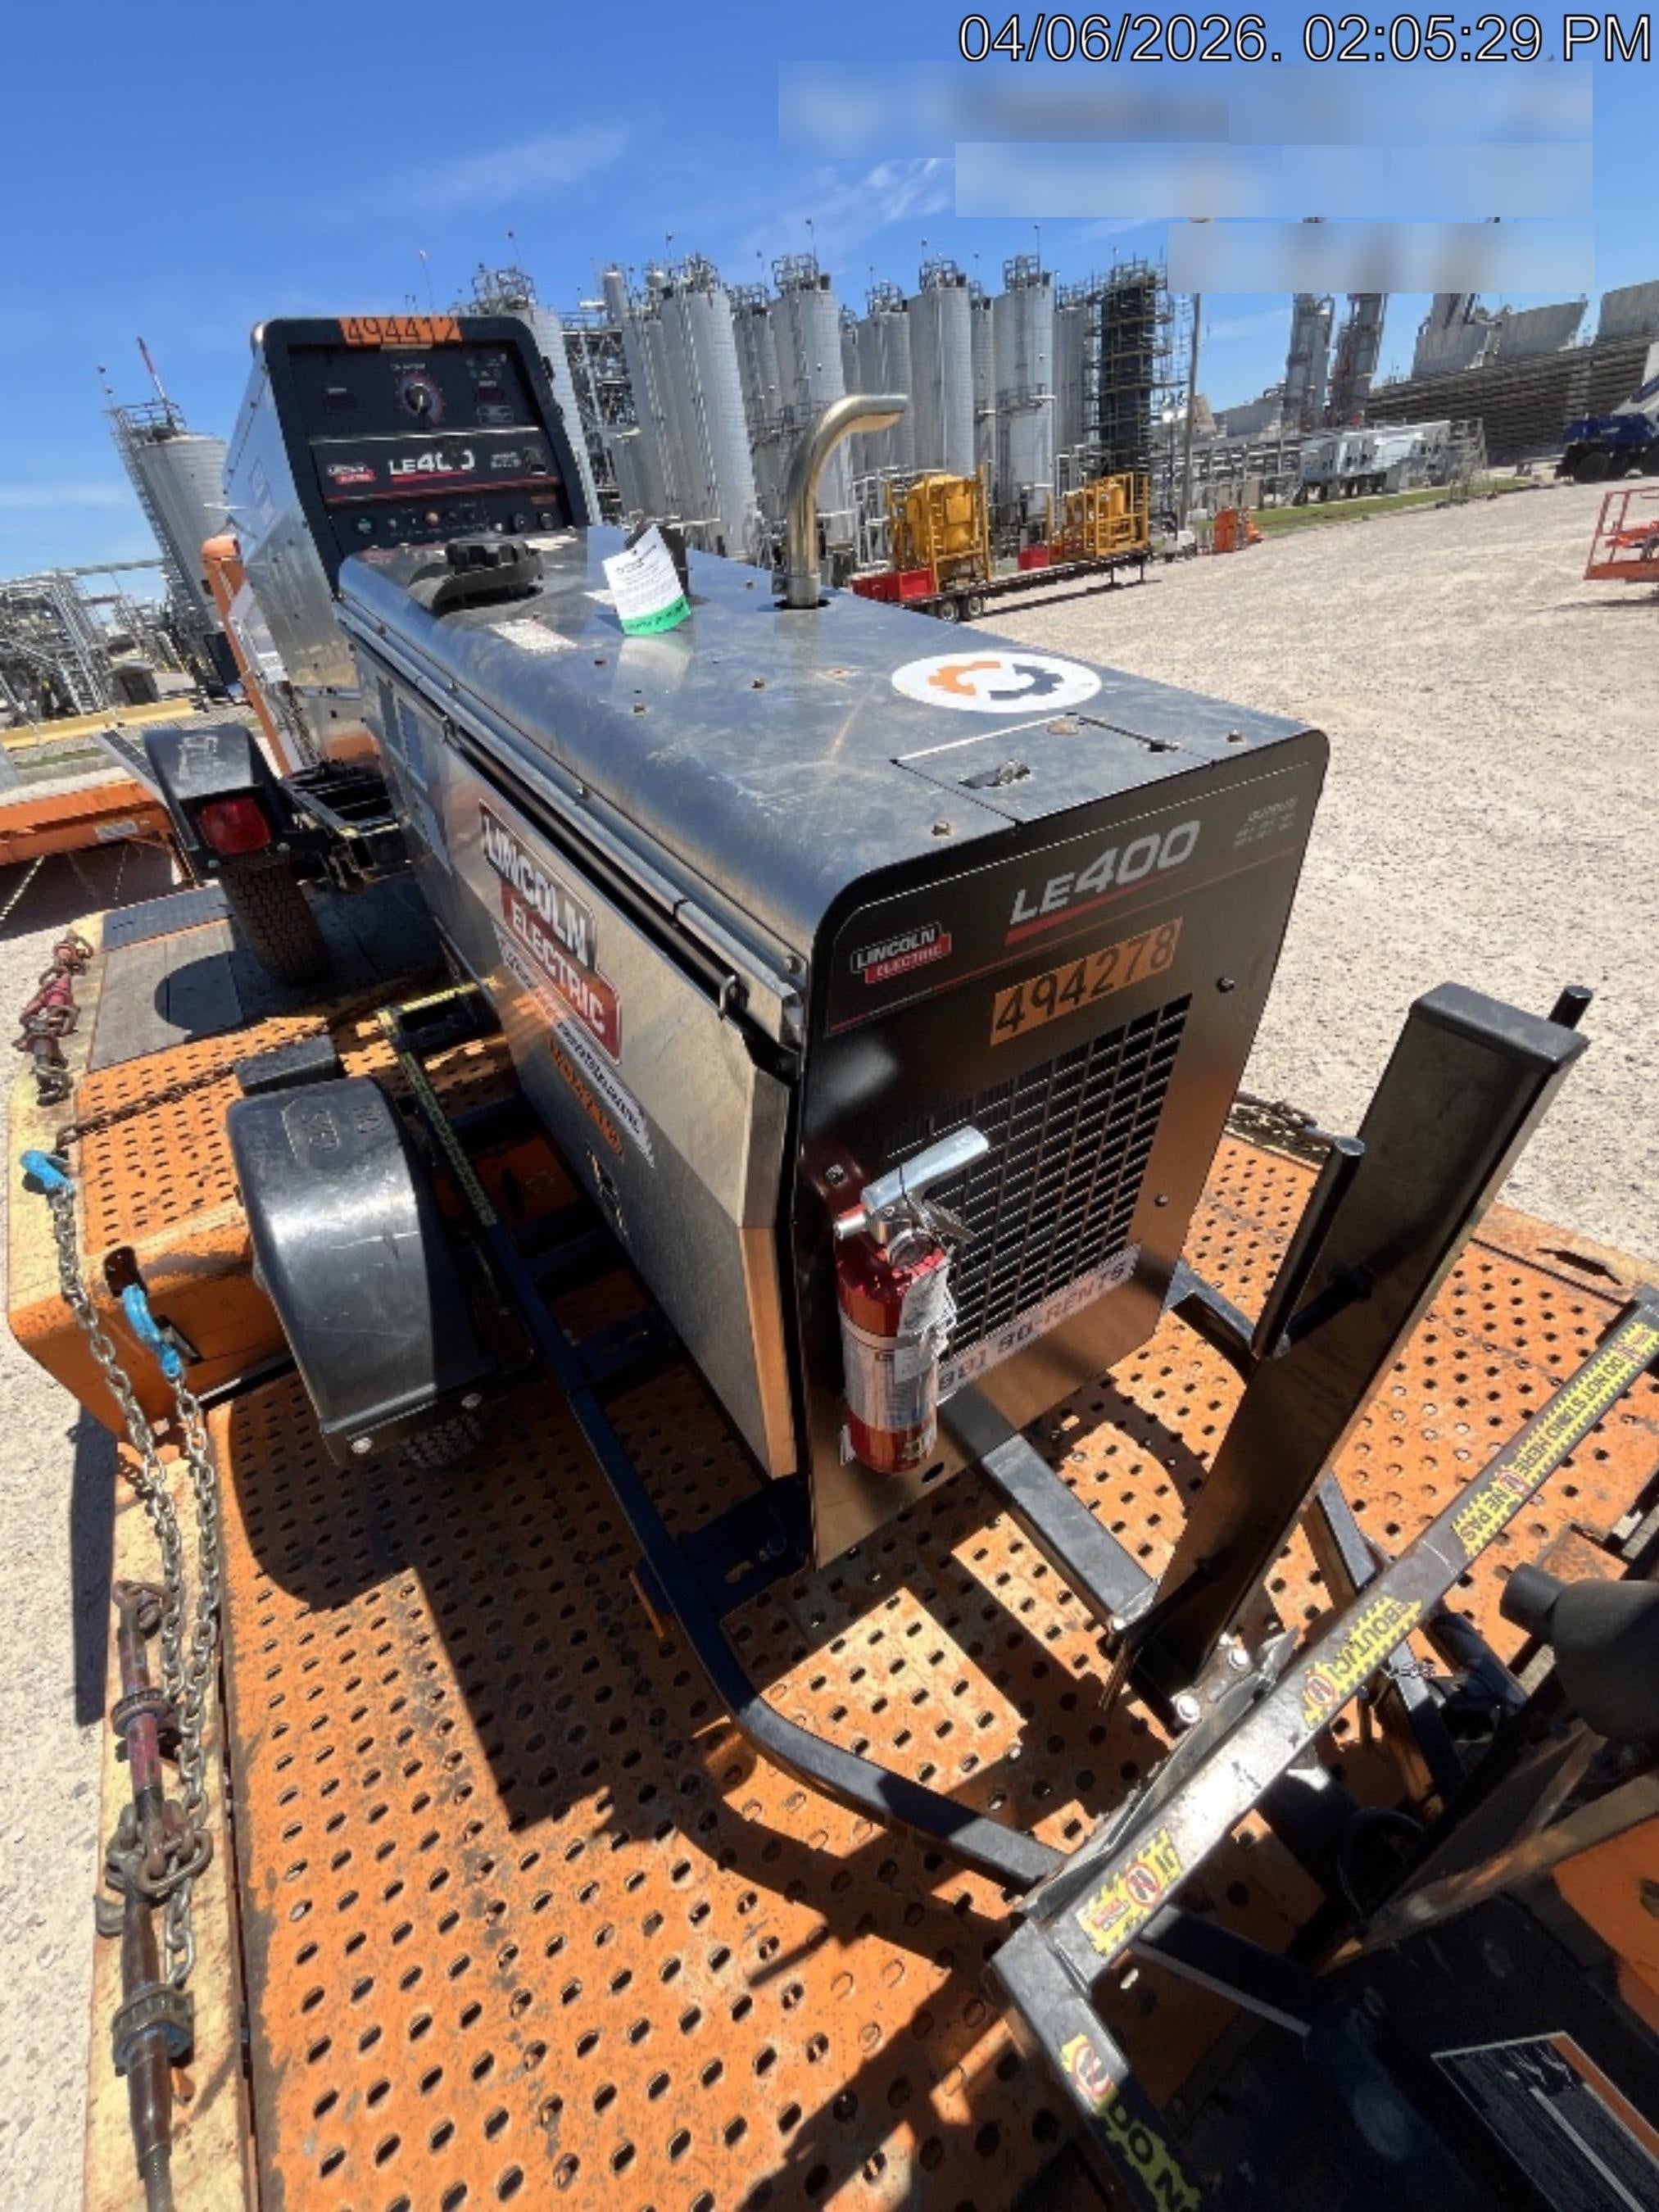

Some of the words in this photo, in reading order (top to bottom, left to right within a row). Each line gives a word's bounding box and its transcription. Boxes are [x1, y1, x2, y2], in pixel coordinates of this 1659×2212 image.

[483, 815, 587, 967] LINCOLN
[1009, 820, 1200, 925] LE400
[510, 898, 606, 1035] ELECTRIC
[857, 927, 936, 969] LINCOLN
[877, 942, 943, 977] ELECTRIC
[995, 923, 1175, 1033] 494278
[1545, 1396, 1586, 1439] STD
